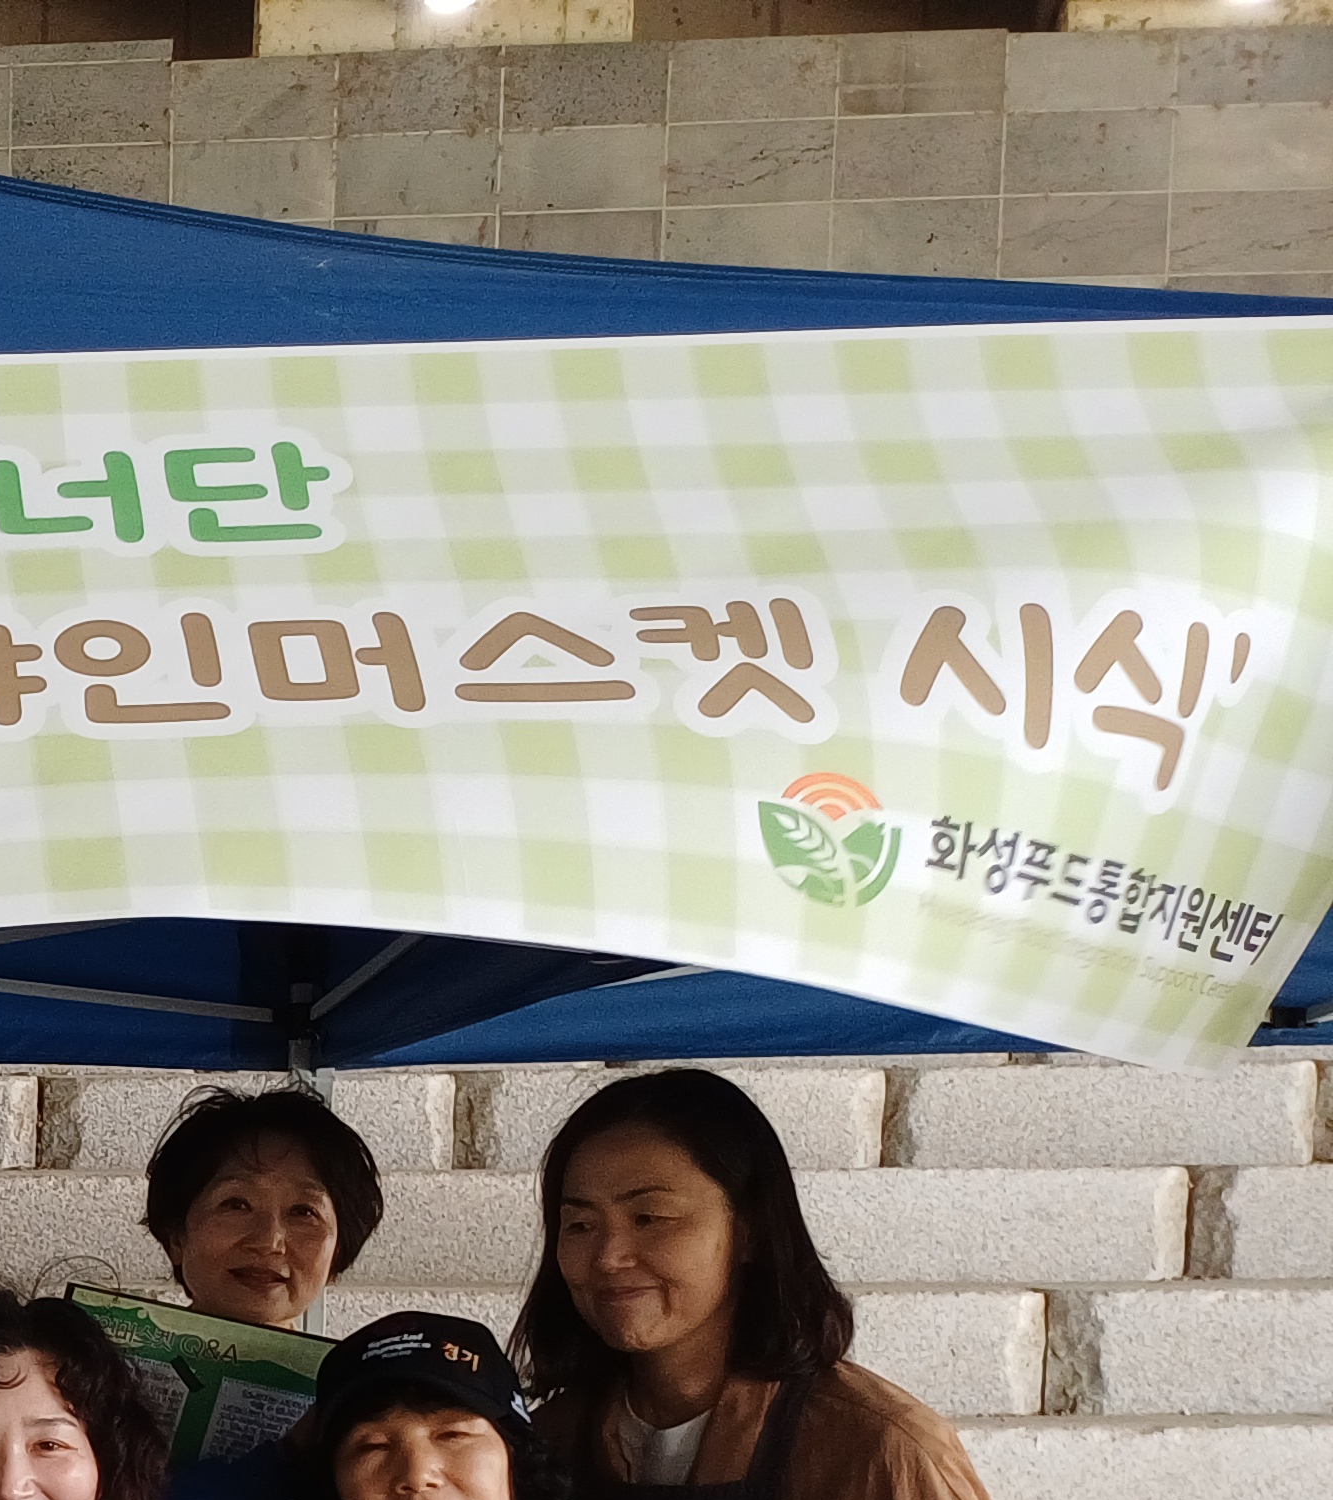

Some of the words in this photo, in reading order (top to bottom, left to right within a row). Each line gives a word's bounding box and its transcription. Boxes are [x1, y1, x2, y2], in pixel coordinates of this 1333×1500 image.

[899, 600, 1250, 792] 시식'
[925, 814, 1286, 966] 화성푸드통합지원센터
[93, 1313, 176, 1353] 인머스켓
[180, 1333, 238, 1365] Q&A
